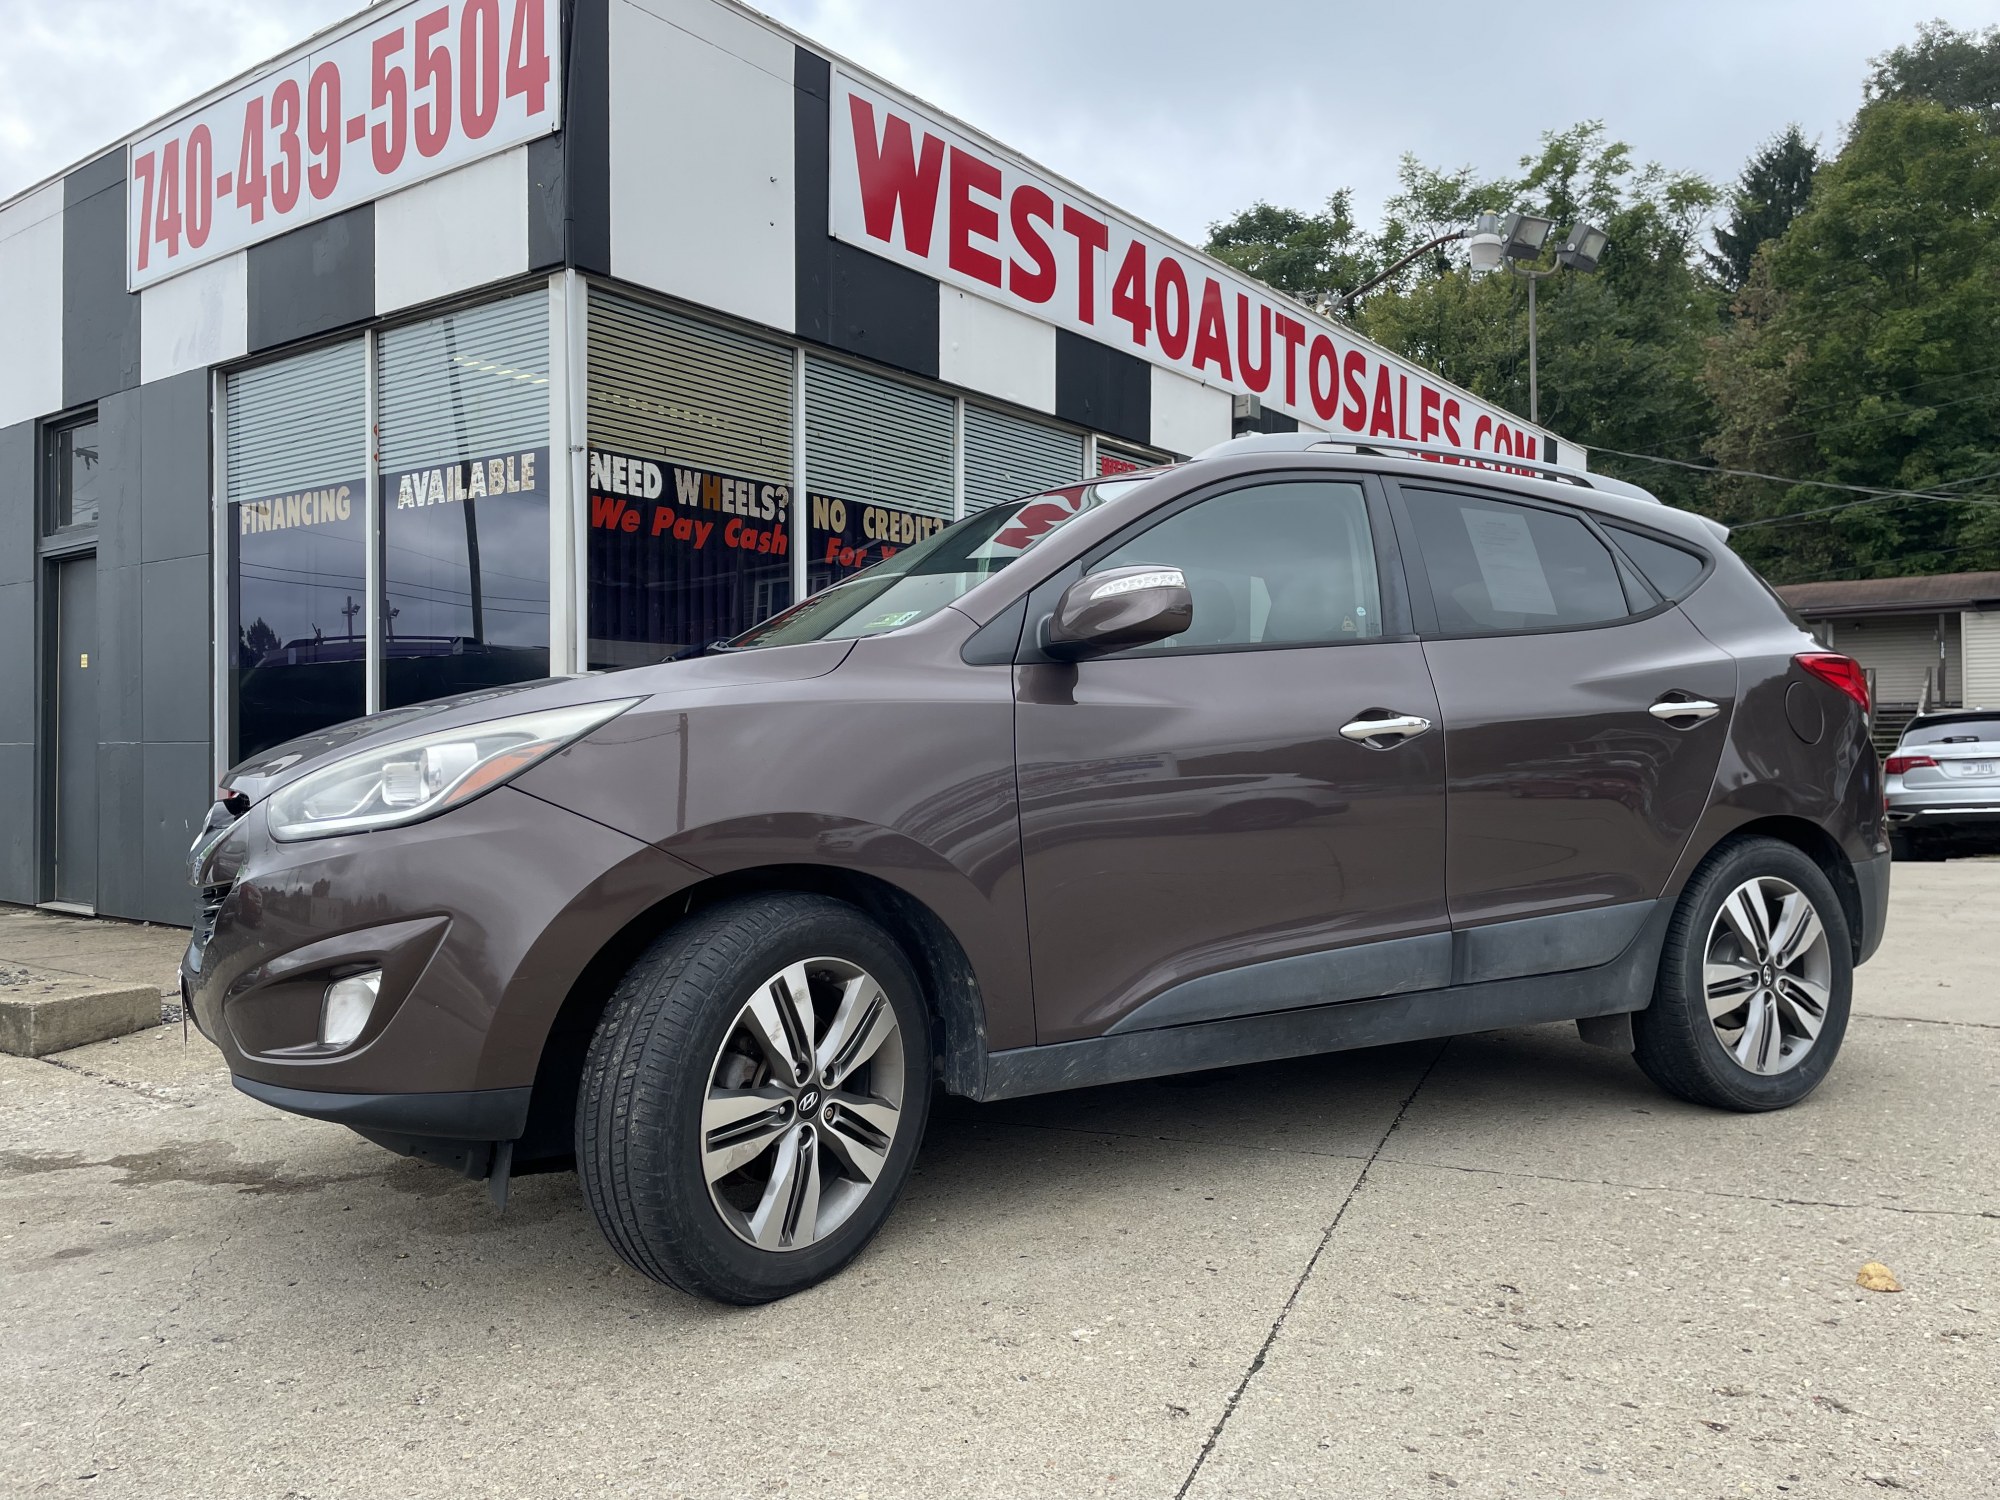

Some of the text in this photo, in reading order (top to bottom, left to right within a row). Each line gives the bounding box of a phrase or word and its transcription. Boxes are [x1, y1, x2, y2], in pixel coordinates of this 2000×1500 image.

[134, 0, 550, 271] 740-439-5504
[848, 92, 1536, 477] WEST40AUTOSALES.COM
[240, 453, 536, 536] FINANCING AVAILABLE
[590, 451, 663, 500] NEED
[674, 467, 790, 523] WHEELS?
[813, 496, 847, 534] NO
[591, 495, 641, 533] We
[651, 506, 714, 550] Pay
[724, 518, 789, 555] Cash
[825, 537, 868, 568] For
